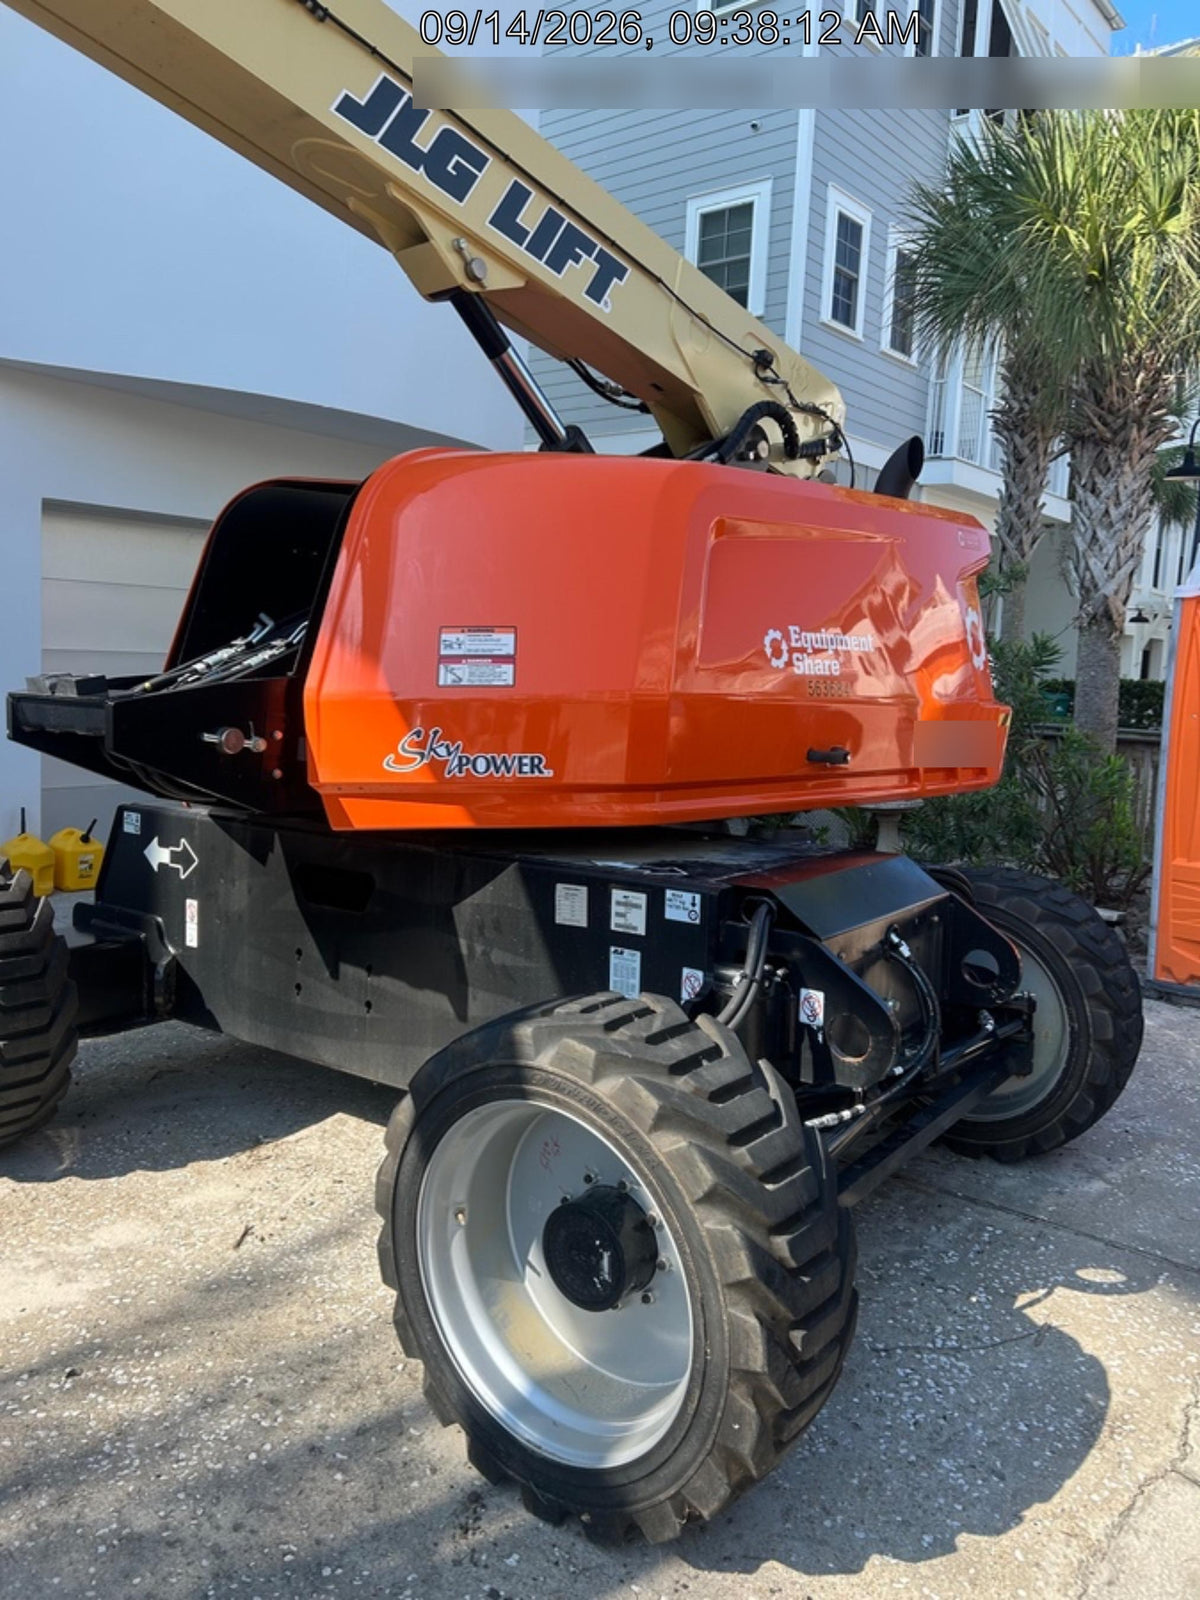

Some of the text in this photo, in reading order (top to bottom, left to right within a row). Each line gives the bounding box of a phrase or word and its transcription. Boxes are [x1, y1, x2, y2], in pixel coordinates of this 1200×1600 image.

[330, 73, 631, 306] JLG LIFT
[788, 625, 875, 654] Equipment
[793, 653, 840, 676] Share
